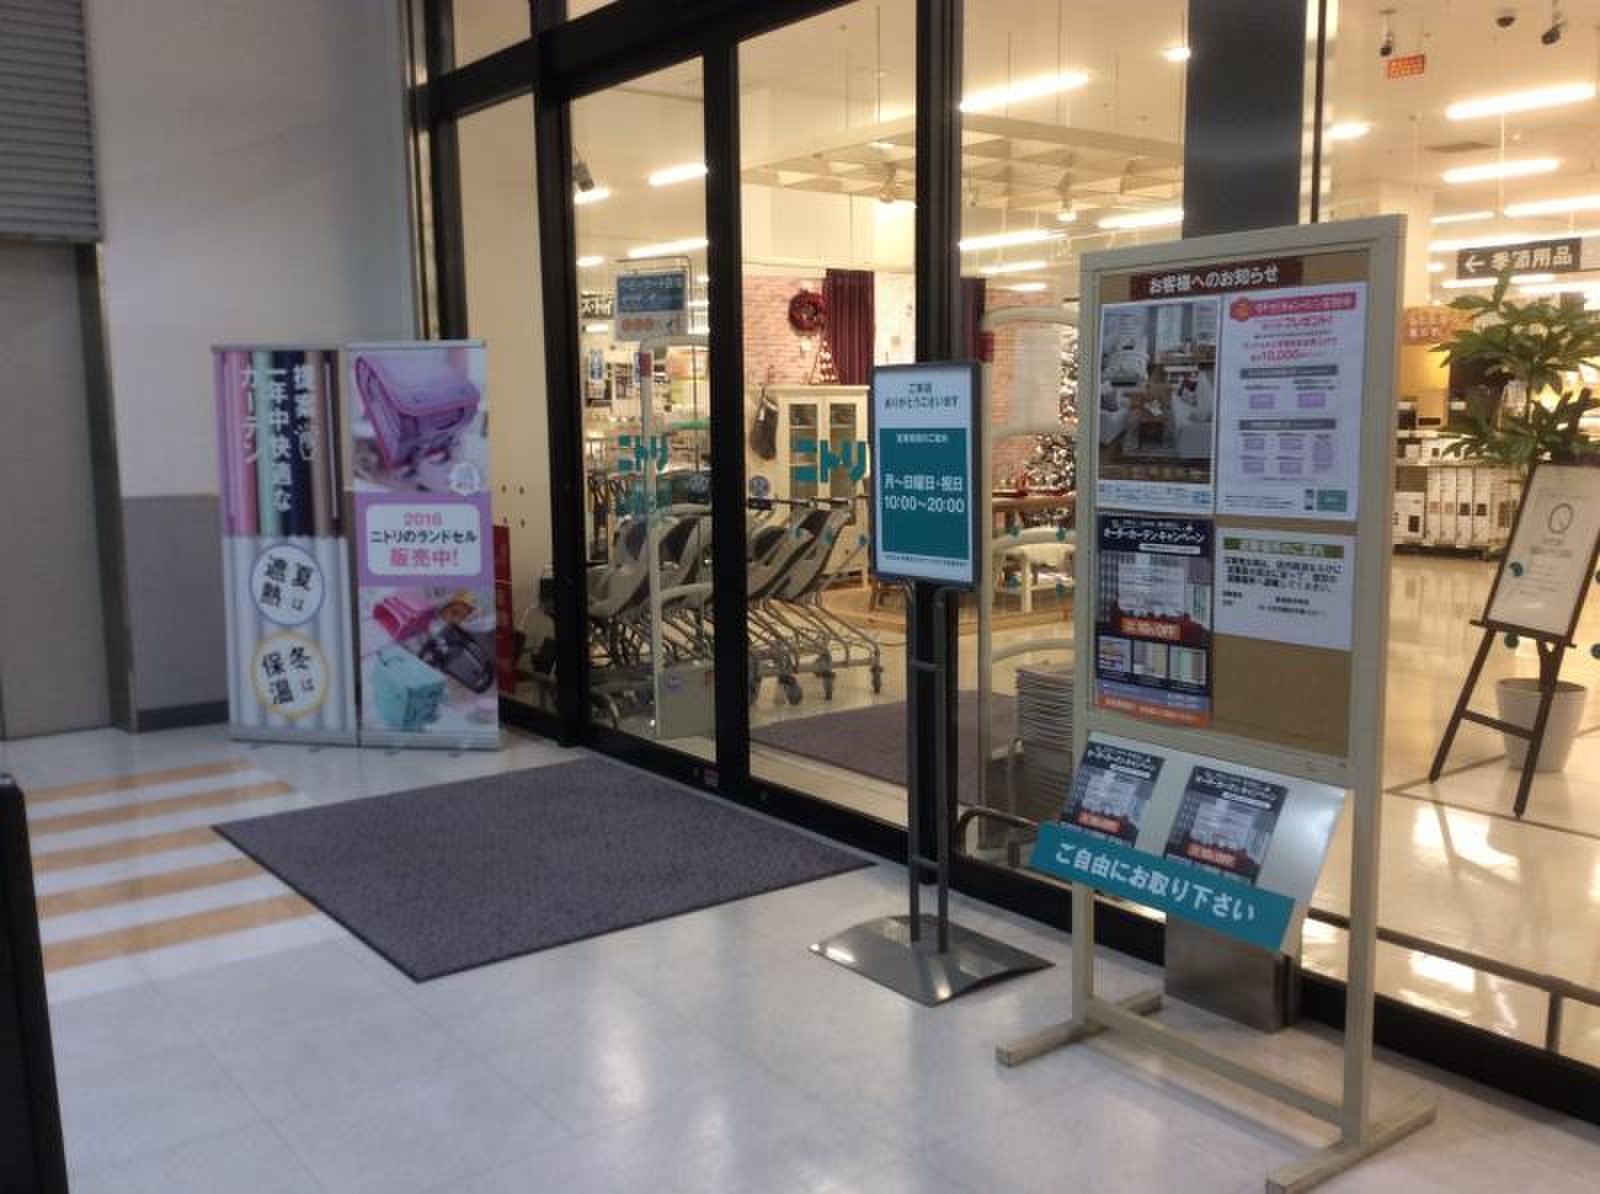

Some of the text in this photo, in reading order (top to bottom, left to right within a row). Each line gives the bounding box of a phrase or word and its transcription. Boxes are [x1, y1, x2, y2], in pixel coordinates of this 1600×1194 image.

[1149, 263, 1279, 295] お客様へのお知らせ
[790, 438, 867, 483] ニトリ
[370, 529, 479, 544] ニトリのランドセル
[1054, 841, 1256, 923] ご自由にお取り下さい
